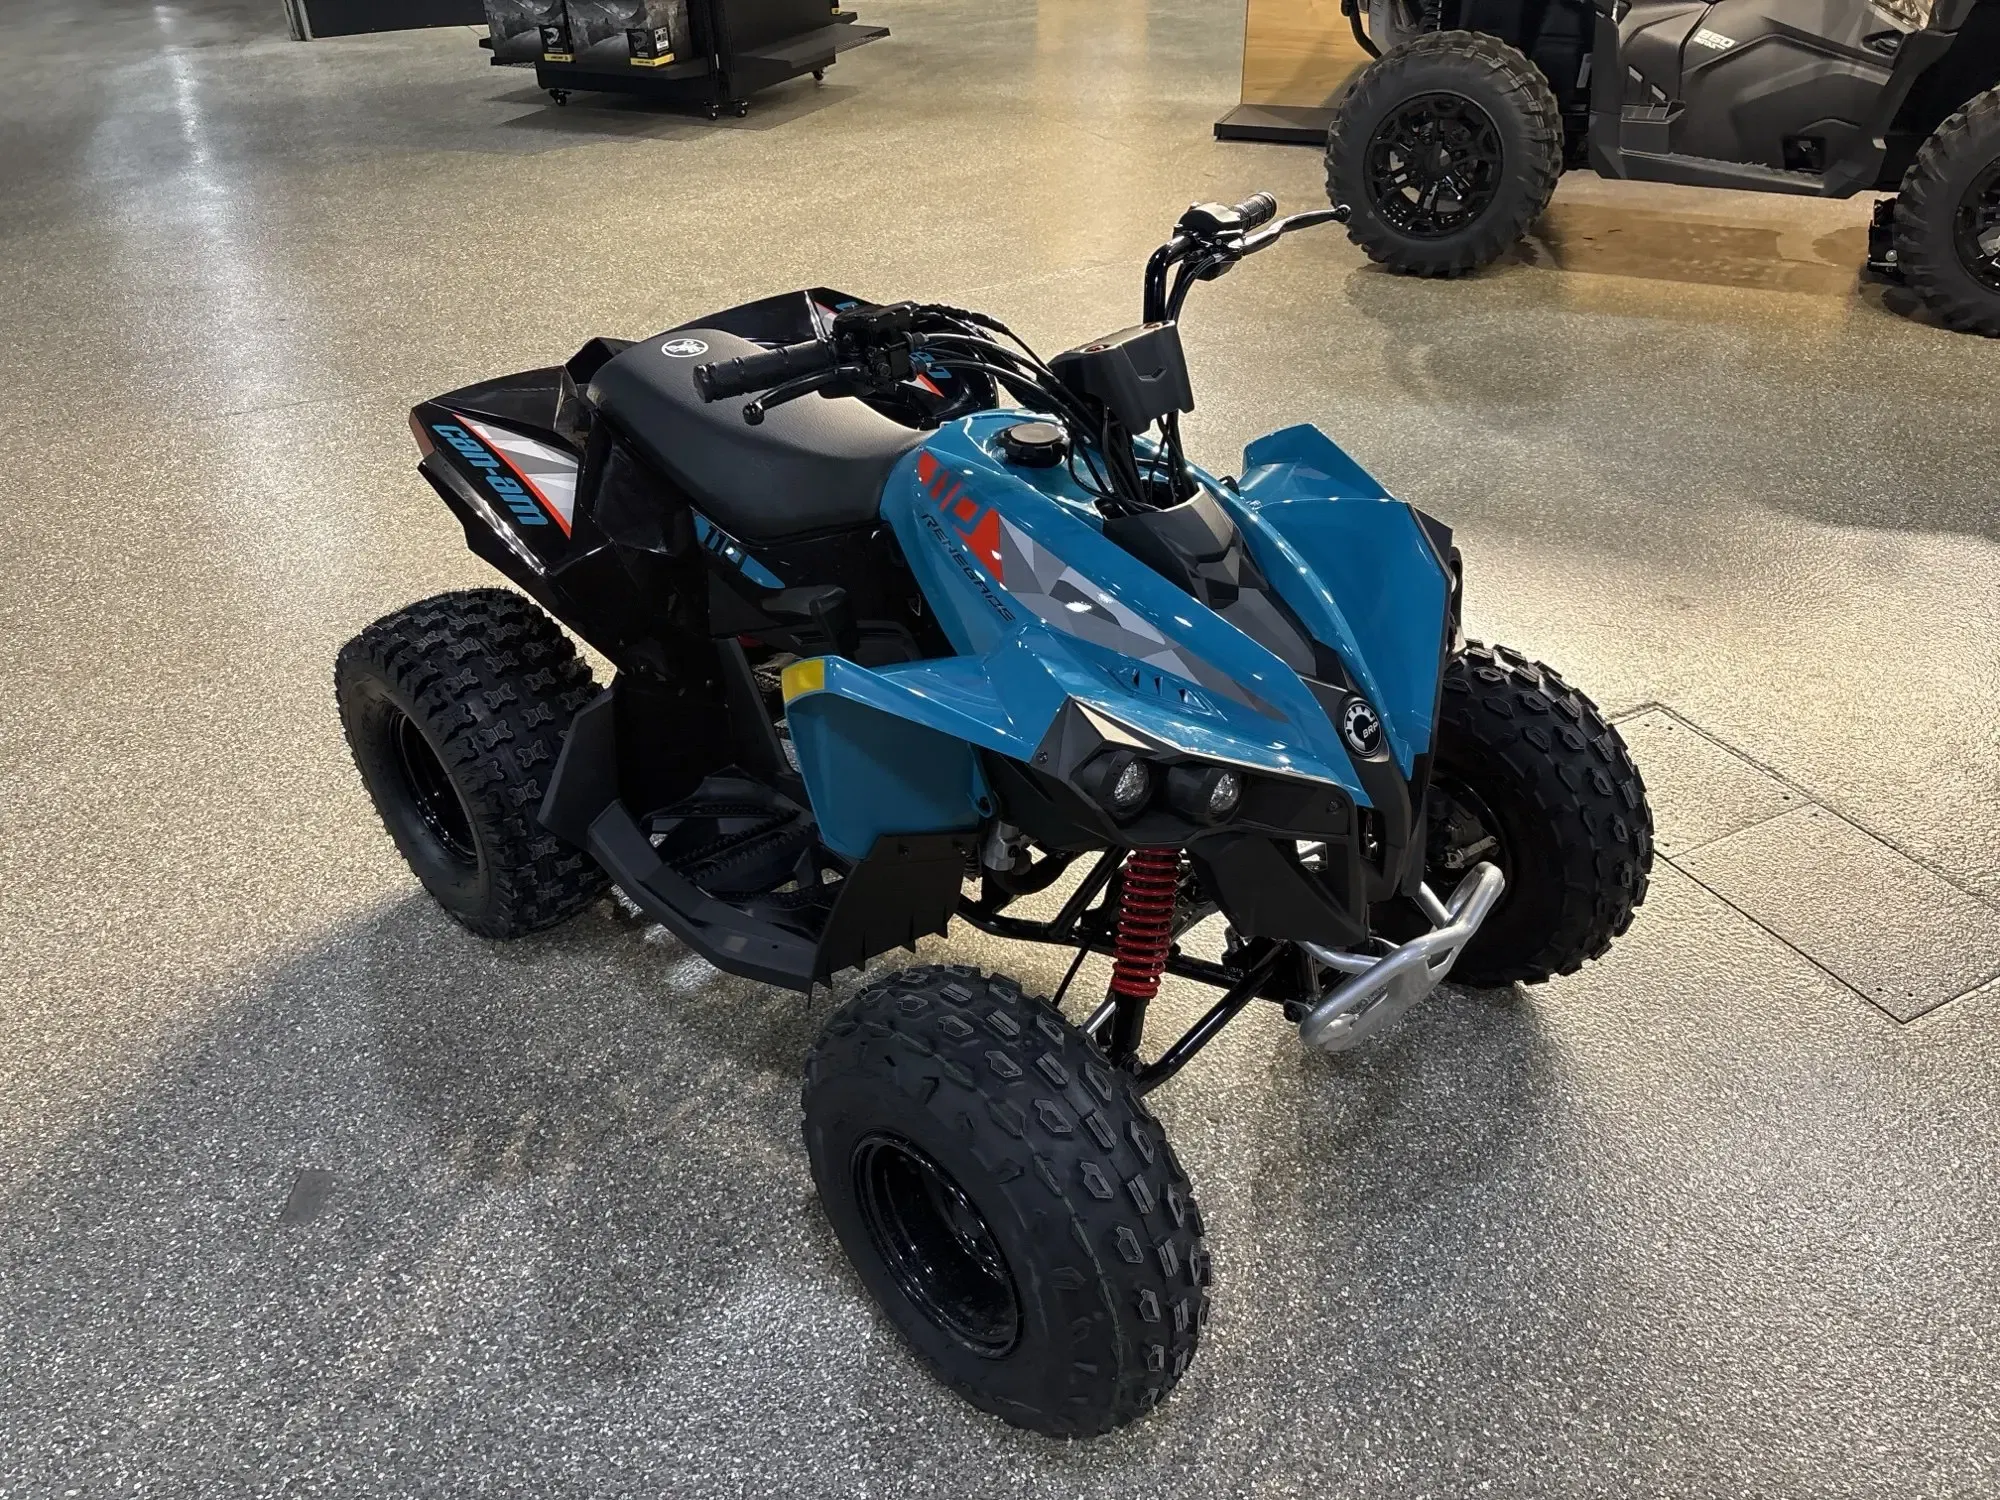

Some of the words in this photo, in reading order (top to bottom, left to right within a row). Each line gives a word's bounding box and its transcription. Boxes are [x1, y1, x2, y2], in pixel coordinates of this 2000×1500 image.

[432, 424, 549, 525] can-am
[921, 512, 1017, 622] RENEGADE
[1362, 721, 1379, 739] BRP
